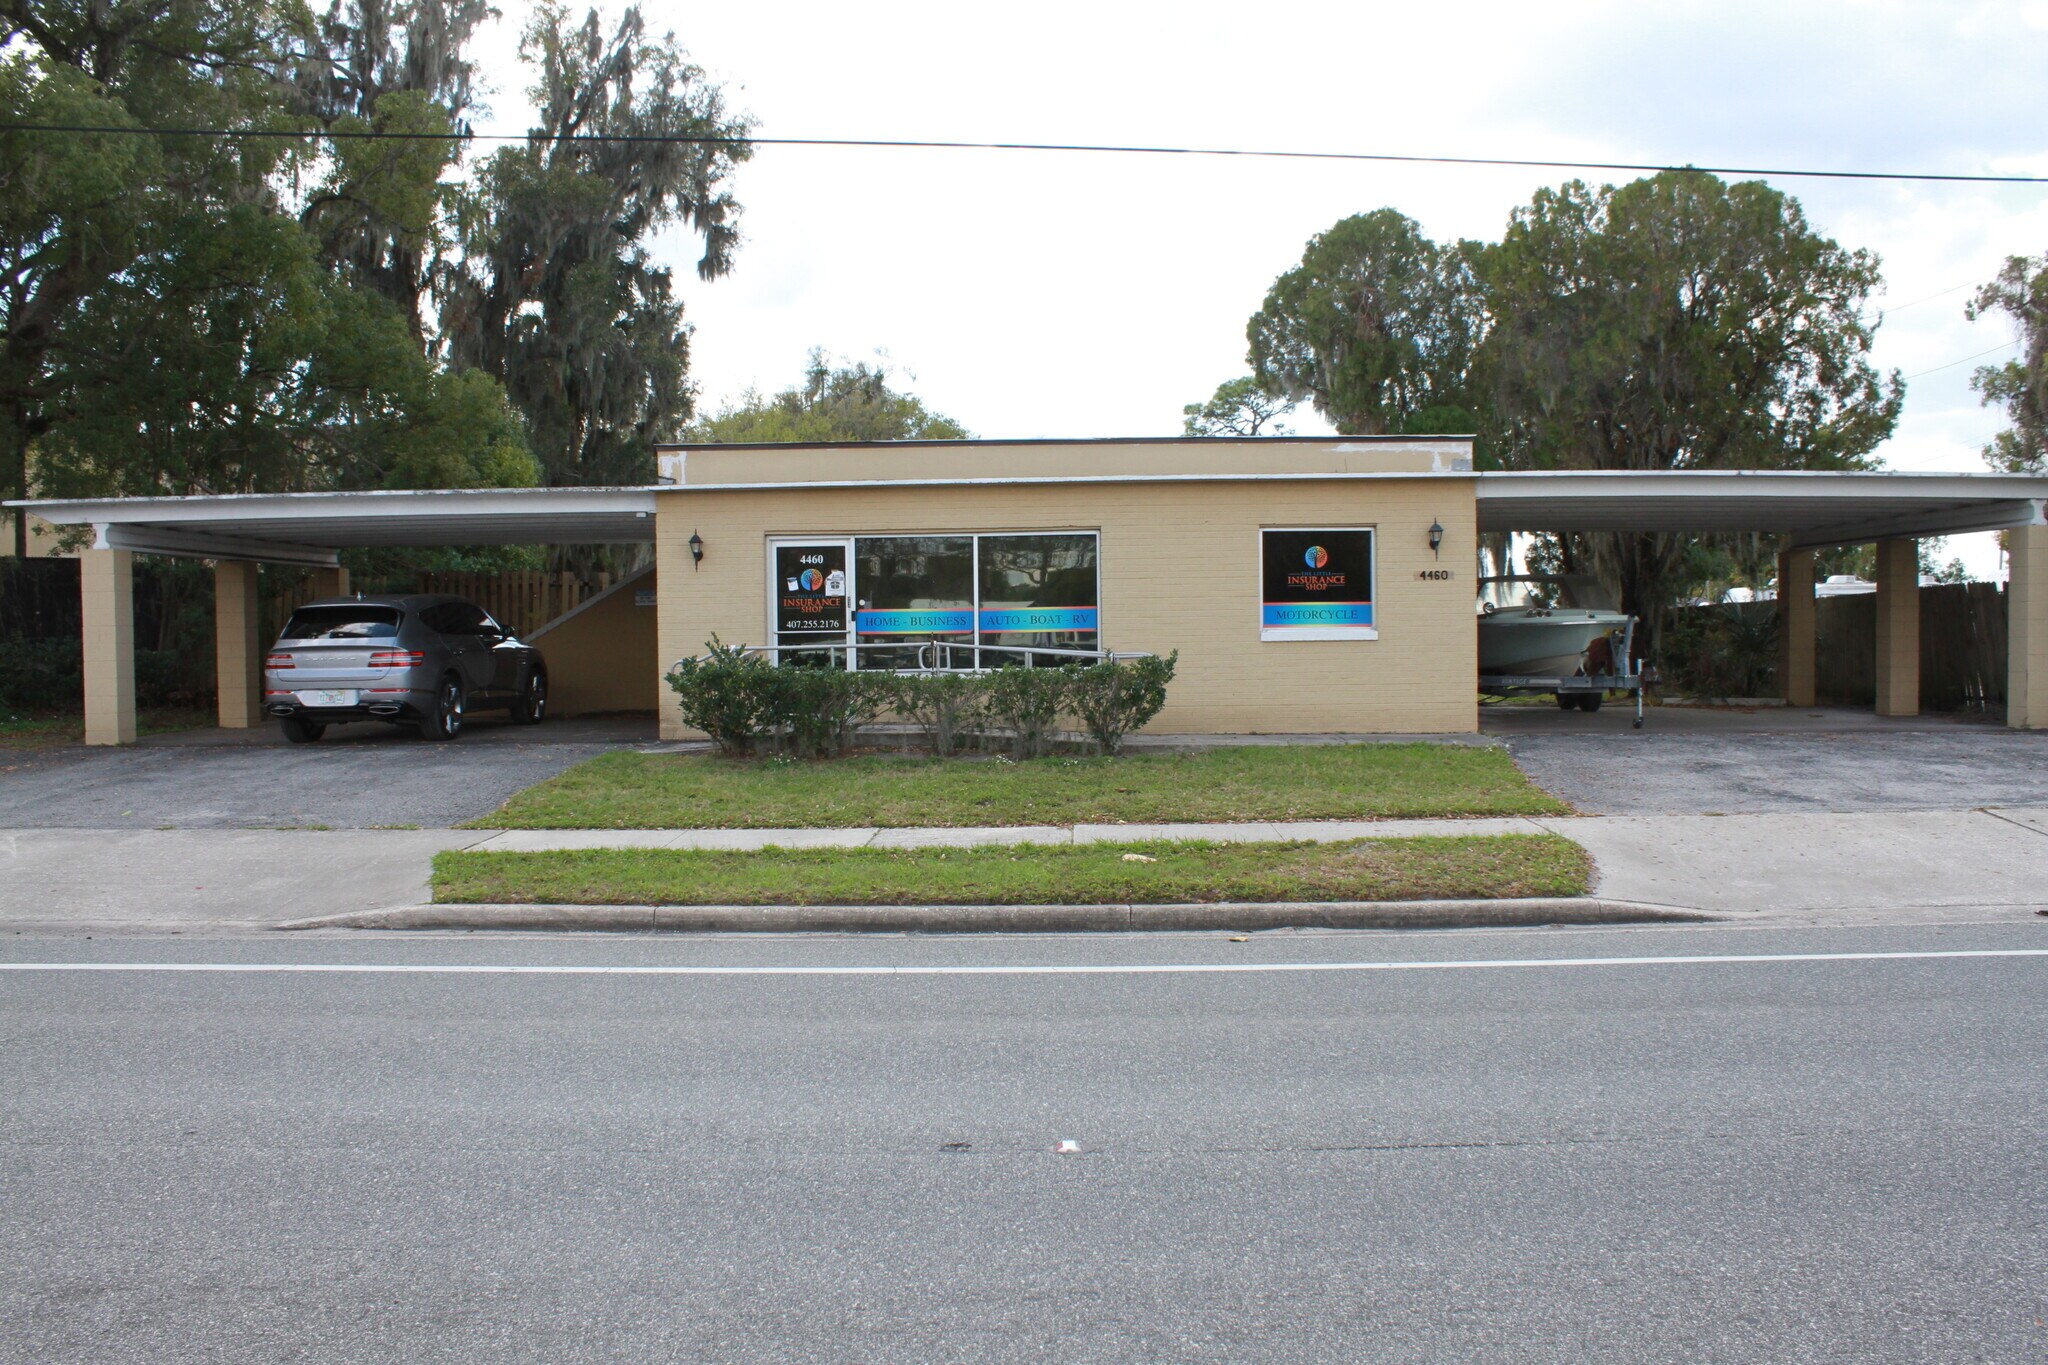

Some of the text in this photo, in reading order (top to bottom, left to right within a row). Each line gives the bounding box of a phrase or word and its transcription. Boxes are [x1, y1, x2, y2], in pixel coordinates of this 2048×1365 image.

[799, 554, 824, 564] 4460
[1287, 575, 1346, 584] INSURANCE
[1419, 570, 1449, 581] 4460
[1305, 583, 1328, 591] SHOP
[783, 598, 841, 607] INSURANCE
[986, 615, 1021, 626] AUTO
[1030, 614, 1063, 625] BOAT
[1072, 613, 1090, 624] RV
[1276, 609, 1359, 620] MOTORCYCLE
[786, 619, 840, 629] 407.255.2176
[865, 617, 901, 627] HOME
[910, 616, 967, 626] BUSINESS
